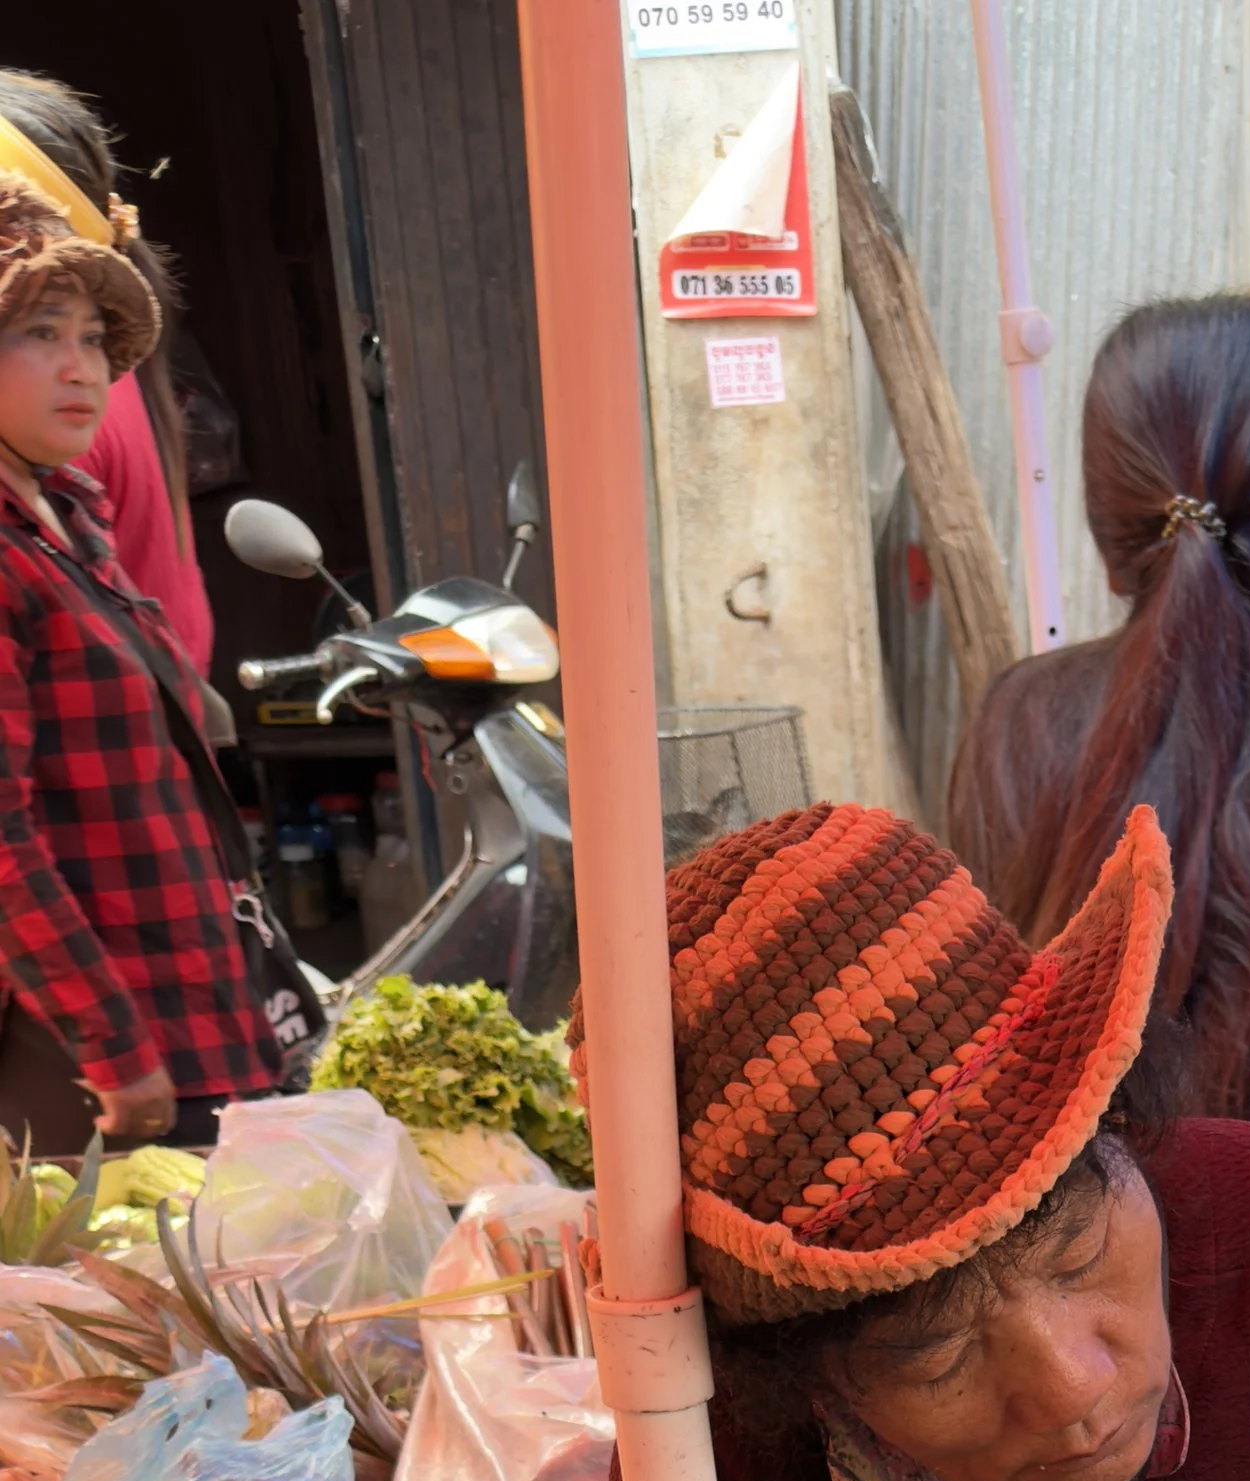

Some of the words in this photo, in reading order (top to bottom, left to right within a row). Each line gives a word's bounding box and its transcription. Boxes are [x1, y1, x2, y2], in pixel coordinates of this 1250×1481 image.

[638, 7, 678, 27] 070
[687, 4, 713, 24] 59
[722, 2, 748, 22] 59
[757, 0, 783, 19] 40
[680, 275, 707, 295] 071
[713, 274, 733, 295] 36
[740, 275, 768, 295] 555
[775, 275, 794, 295] 05
